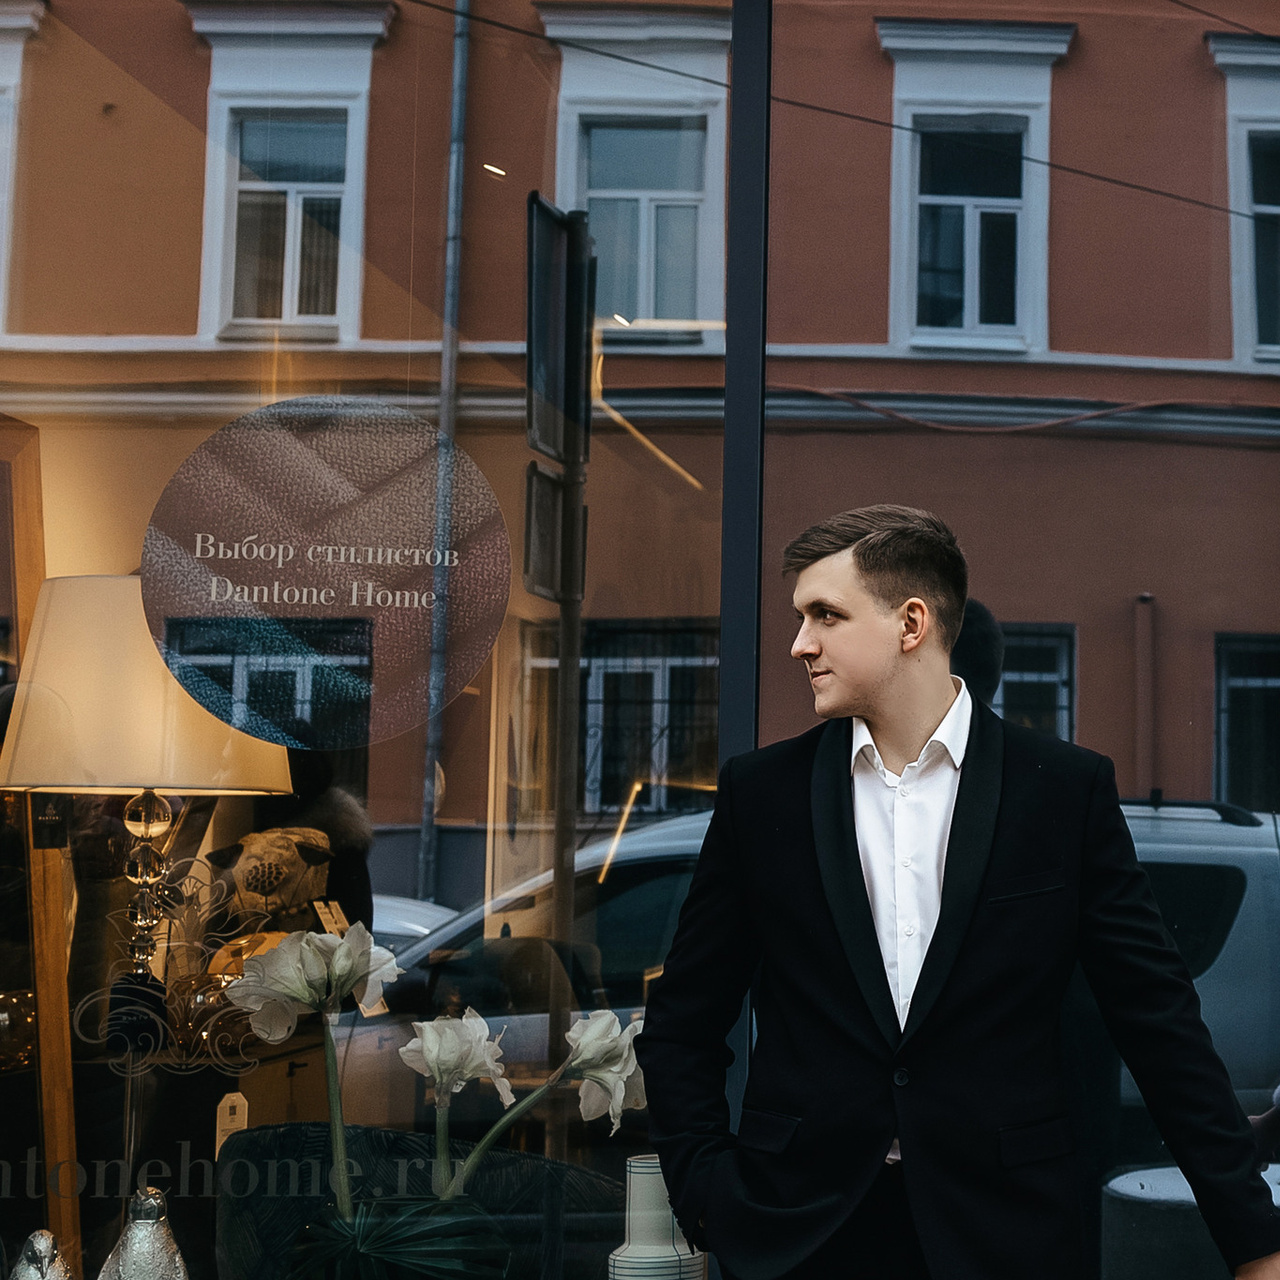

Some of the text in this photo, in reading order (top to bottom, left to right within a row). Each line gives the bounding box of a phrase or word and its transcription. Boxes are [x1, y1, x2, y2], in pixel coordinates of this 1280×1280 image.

[194, 532, 460, 568] Выбор стилистов
[209, 576, 438, 609] Dantone Home
